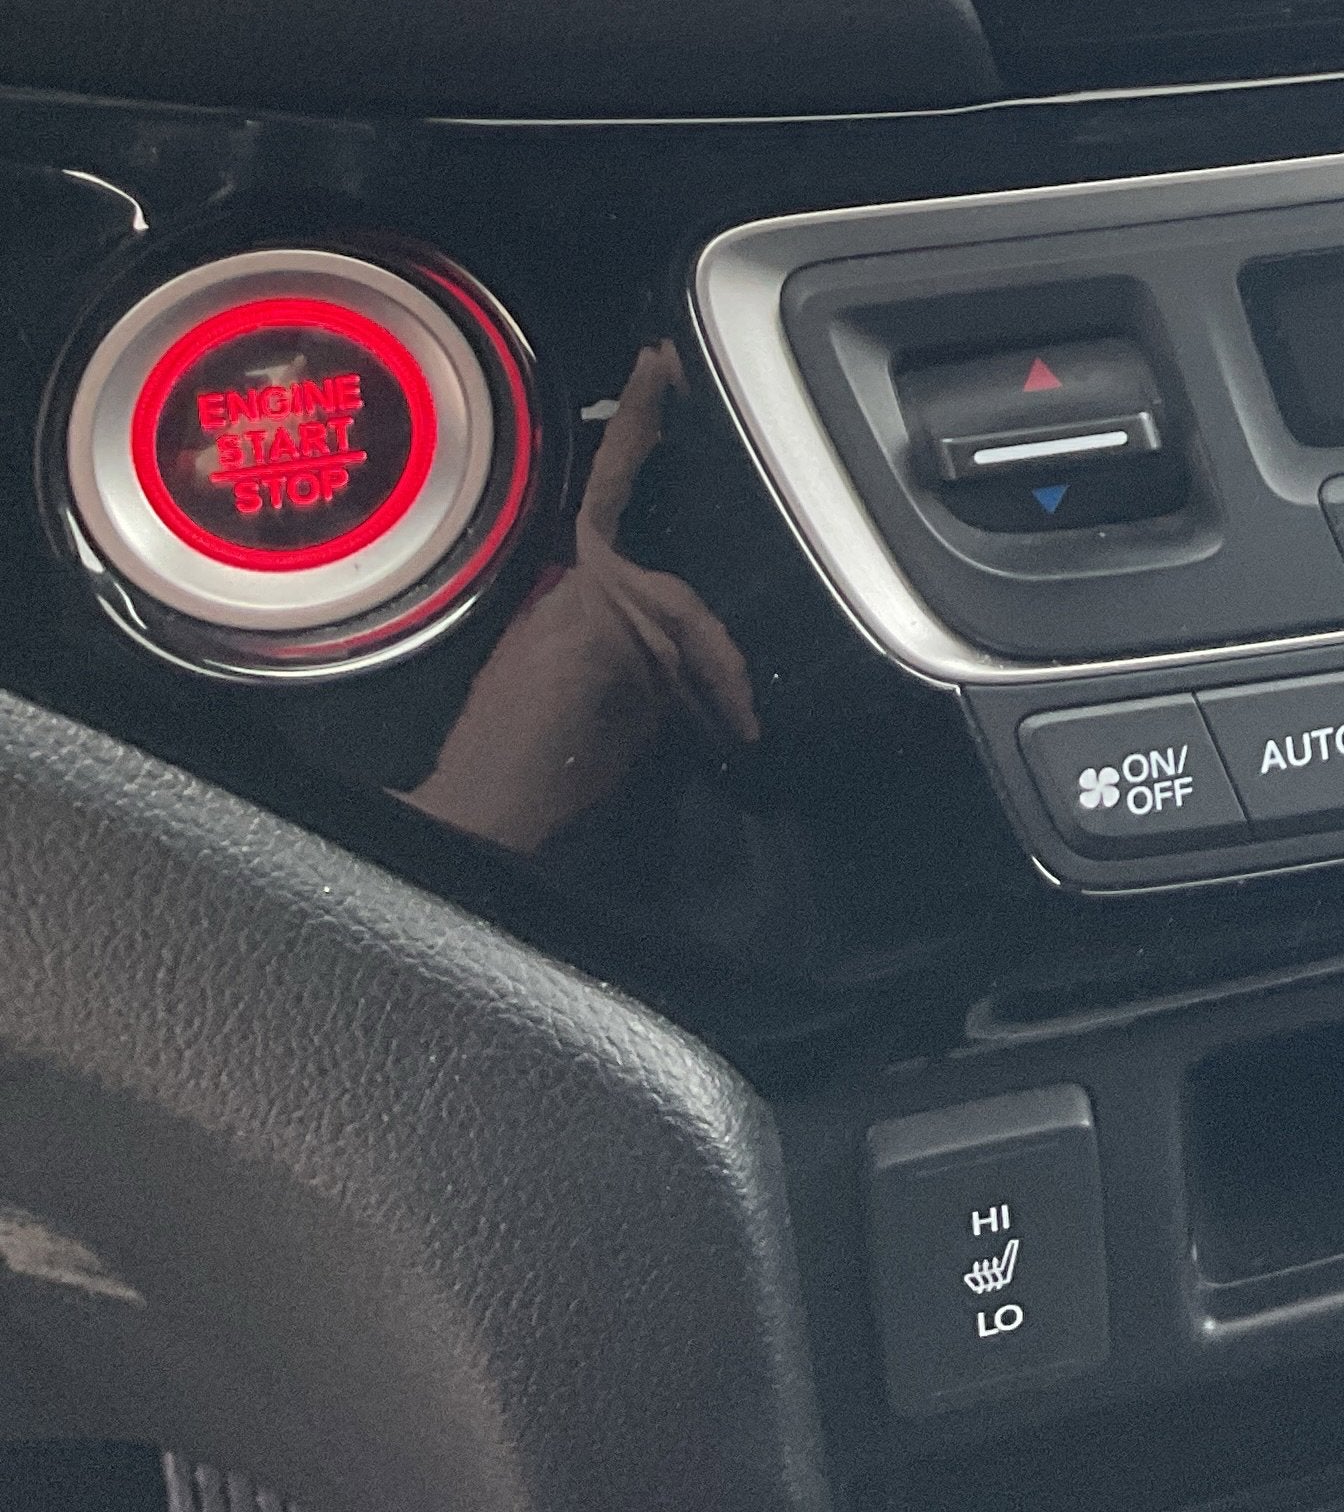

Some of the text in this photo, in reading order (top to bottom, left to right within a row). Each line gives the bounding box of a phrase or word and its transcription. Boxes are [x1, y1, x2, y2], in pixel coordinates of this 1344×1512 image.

[197, 374, 364, 430] ENGINE
[216, 416, 355, 469] START
[234, 467, 349, 513] STOP
[1122, 745, 1189, 783] ON/
[1127, 777, 1193, 815] OFF
[972, 1204, 1010, 1236] HI
[977, 1304, 1023, 1338] LO
